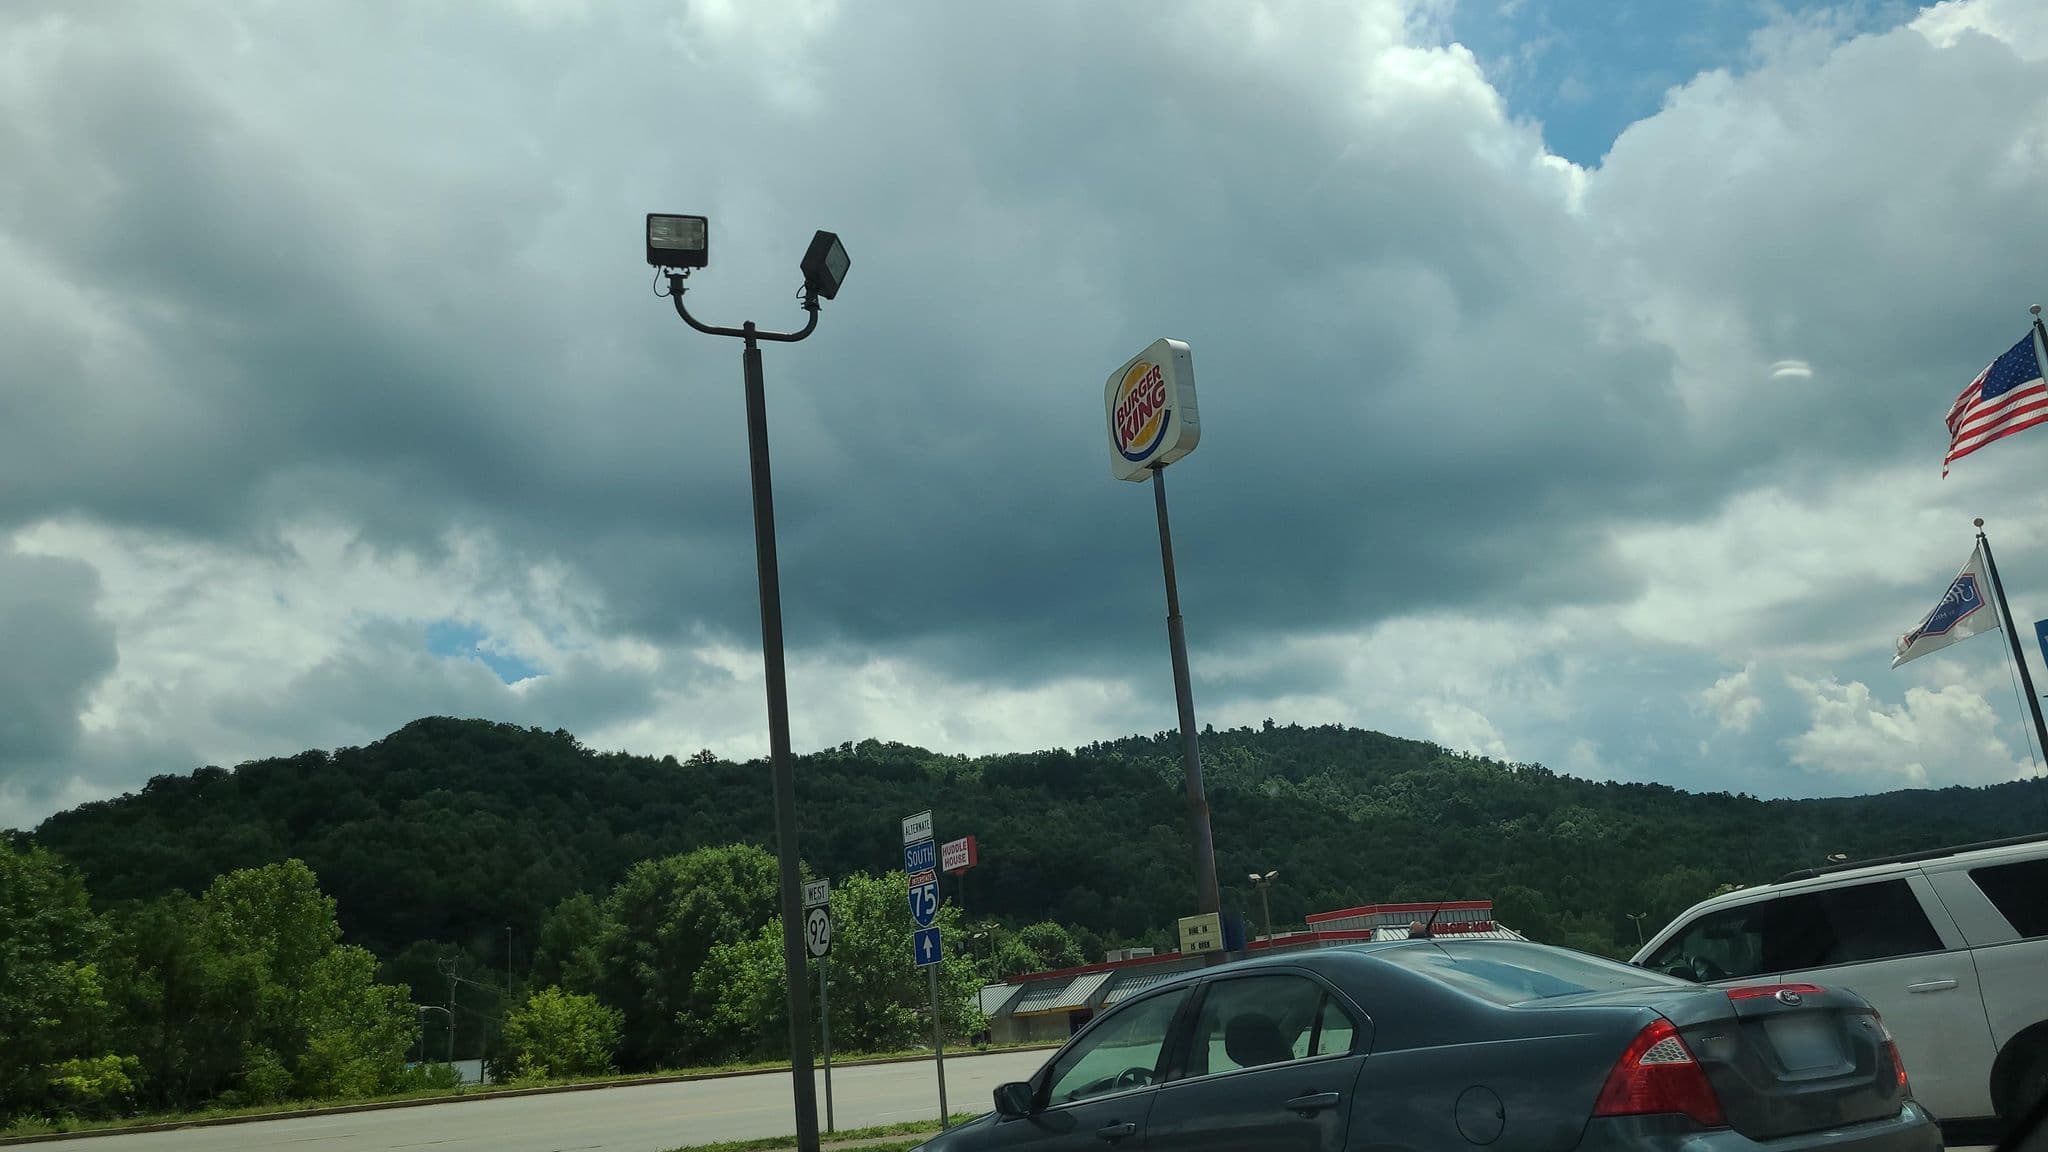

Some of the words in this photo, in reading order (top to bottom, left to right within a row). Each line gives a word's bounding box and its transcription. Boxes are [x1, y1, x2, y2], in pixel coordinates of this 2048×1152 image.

[1117, 365, 1162, 429] BURGER
[1120, 380, 1166, 450] KING
[905, 819, 930, 835] ALTERNATE
[907, 847, 934, 867] SOUTH
[942, 840, 967, 856] HUDDLE
[944, 853, 967, 868] HOUSE
[807, 885, 825, 901] WEST
[910, 885, 937, 918] 75
[810, 917, 828, 945] 92
